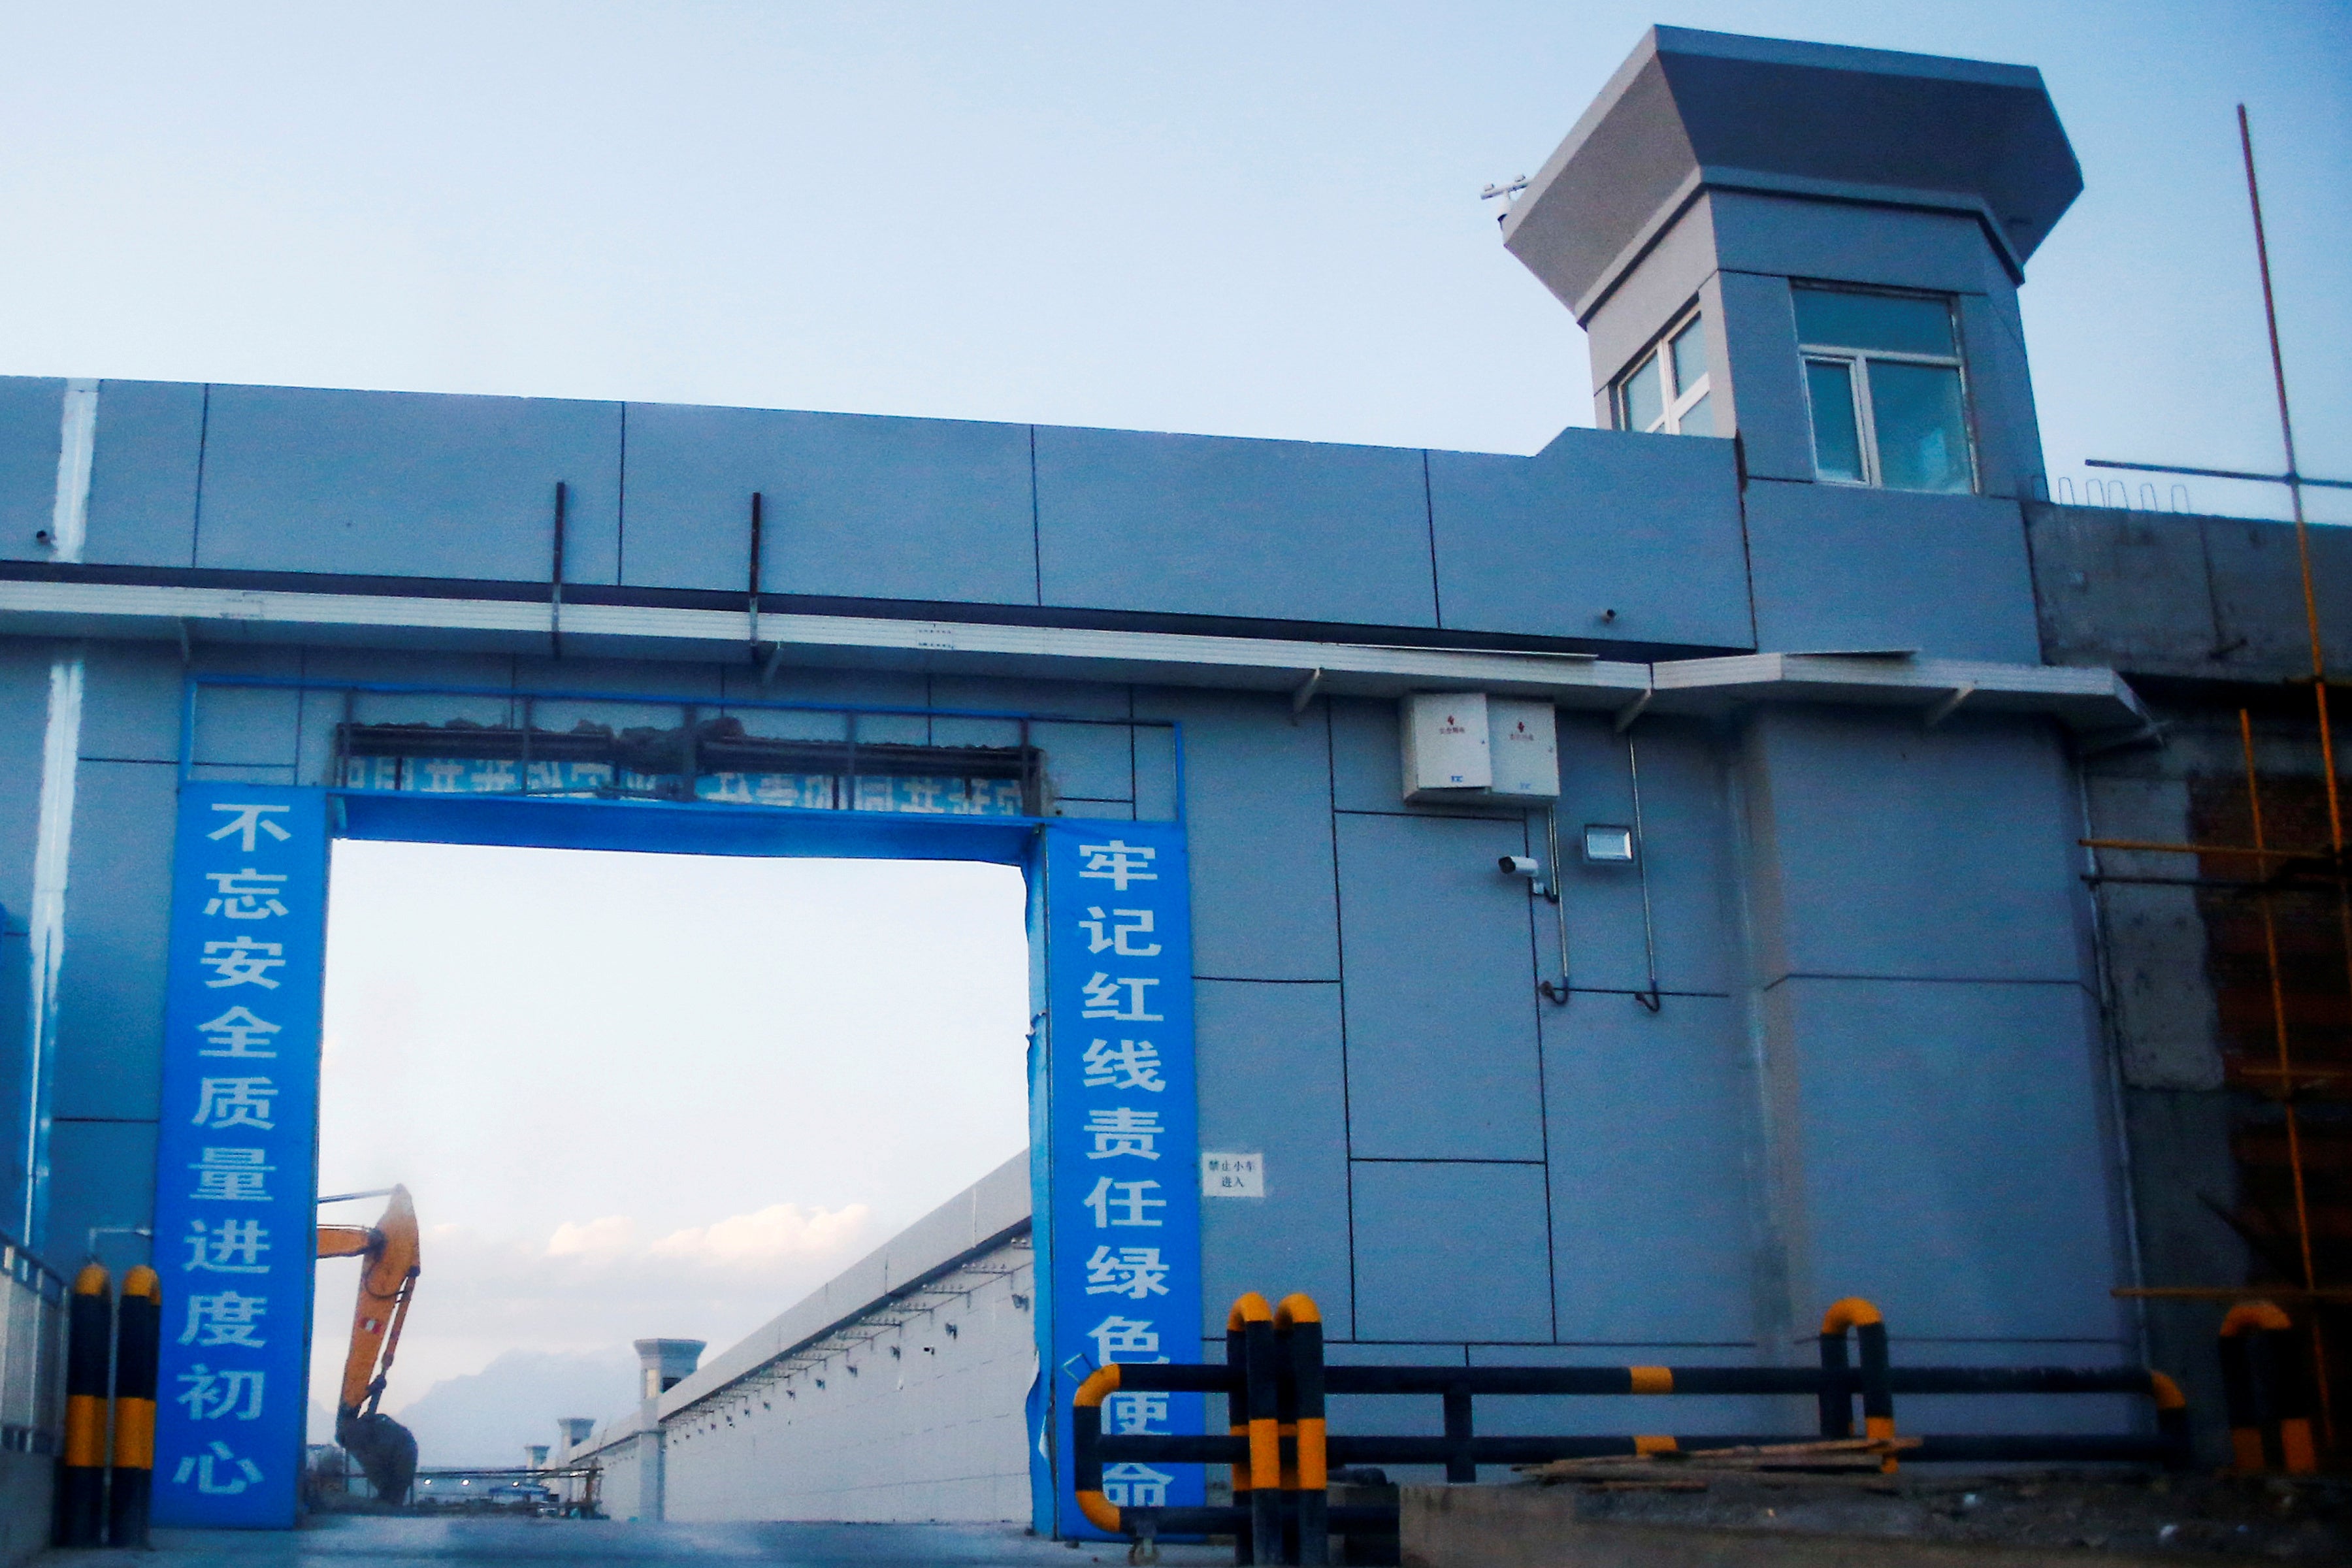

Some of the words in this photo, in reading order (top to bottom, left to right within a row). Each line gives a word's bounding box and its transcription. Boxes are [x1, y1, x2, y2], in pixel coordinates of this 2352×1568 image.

[172, 803, 291, 1495] 不忘安全质量进度初心
[1079, 840, 1175, 1507] 牢记红线责任绿色使命
[1222, 1175, 1245, 1188] 进入
